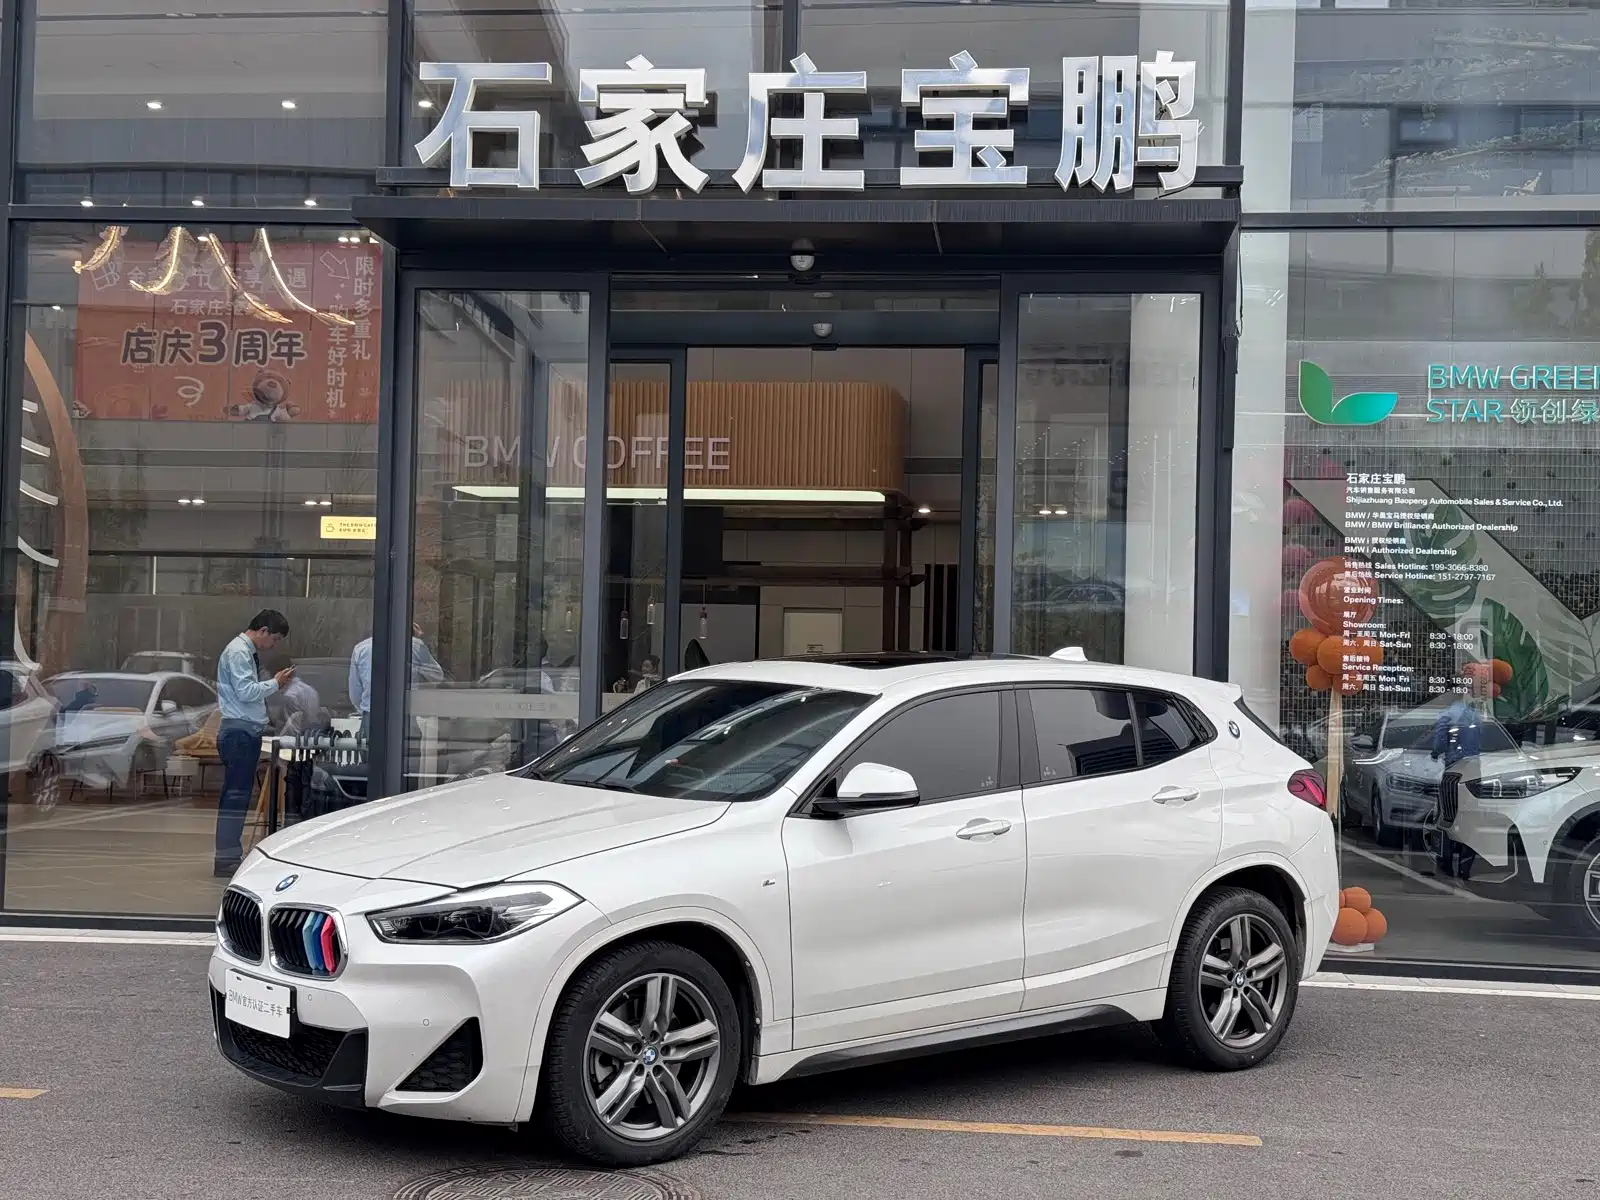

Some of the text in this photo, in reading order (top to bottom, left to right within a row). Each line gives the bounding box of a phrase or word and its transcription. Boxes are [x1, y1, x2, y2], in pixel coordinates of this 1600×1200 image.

[414, 50, 1200, 194] 石家庄宝鹏
[352, 256, 375, 361] 限时多重礼
[121, 321, 307, 368] 店庆3周年
[1427, 364, 1501, 390] BMW
[1427, 398, 1600, 425] STAR 领创绿
[1346, 472, 1406, 485] 石家庄宝鹏
[1345, 496, 1393, 505] Shijiazhuang
[1394, 496, 1428, 505] Baopeng
[1429, 497, 1473, 505] Automobile
[1473, 498, 1494, 506] Sales
[1495, 498, 1501, 506] &
[1502, 498, 1531, 506] Service
[1371, 521, 1393, 529] BMW
[1394, 521, 1431, 530] Brilliance
[1431, 522, 1475, 531] Authorized
[1476, 523, 1519, 532] Dealership
[1344, 536, 1366, 544] BMW
[1371, 546, 1414, 555] Authorized
[1415, 547, 1458, 556] Dealership
[1374, 562, 1396, 570] Sales
[1397, 563, 1429, 571] Hotline:
[1430, 563, 1489, 572] 199-3066-8380
[1374, 571, 1404, 579] Service
[1404, 572, 1436, 580] Hotline:
[1438, 573, 1496, 581] 151-2797-7167
[1343, 595, 1404, 604] Opening Times:
[1342, 620, 1387, 629] Showroom:
[1379, 631, 1411, 639] Mon-Fri
[1429, 632, 1447, 640] 8:30
[1453, 633, 1474, 641] 18:00
[1379, 640, 1412, 648] Sat-Sun
[1429, 641, 1447, 649] 8:30
[1453, 642, 1474, 650] 18:00
[1342, 663, 1414, 673] Service Reception:
[1428, 676, 1446, 684] 8:30
[1452, 677, 1473, 685] 18:00
[1378, 684, 1411, 692] Sat-Sun
[1428, 686, 1446, 694] 8:30
